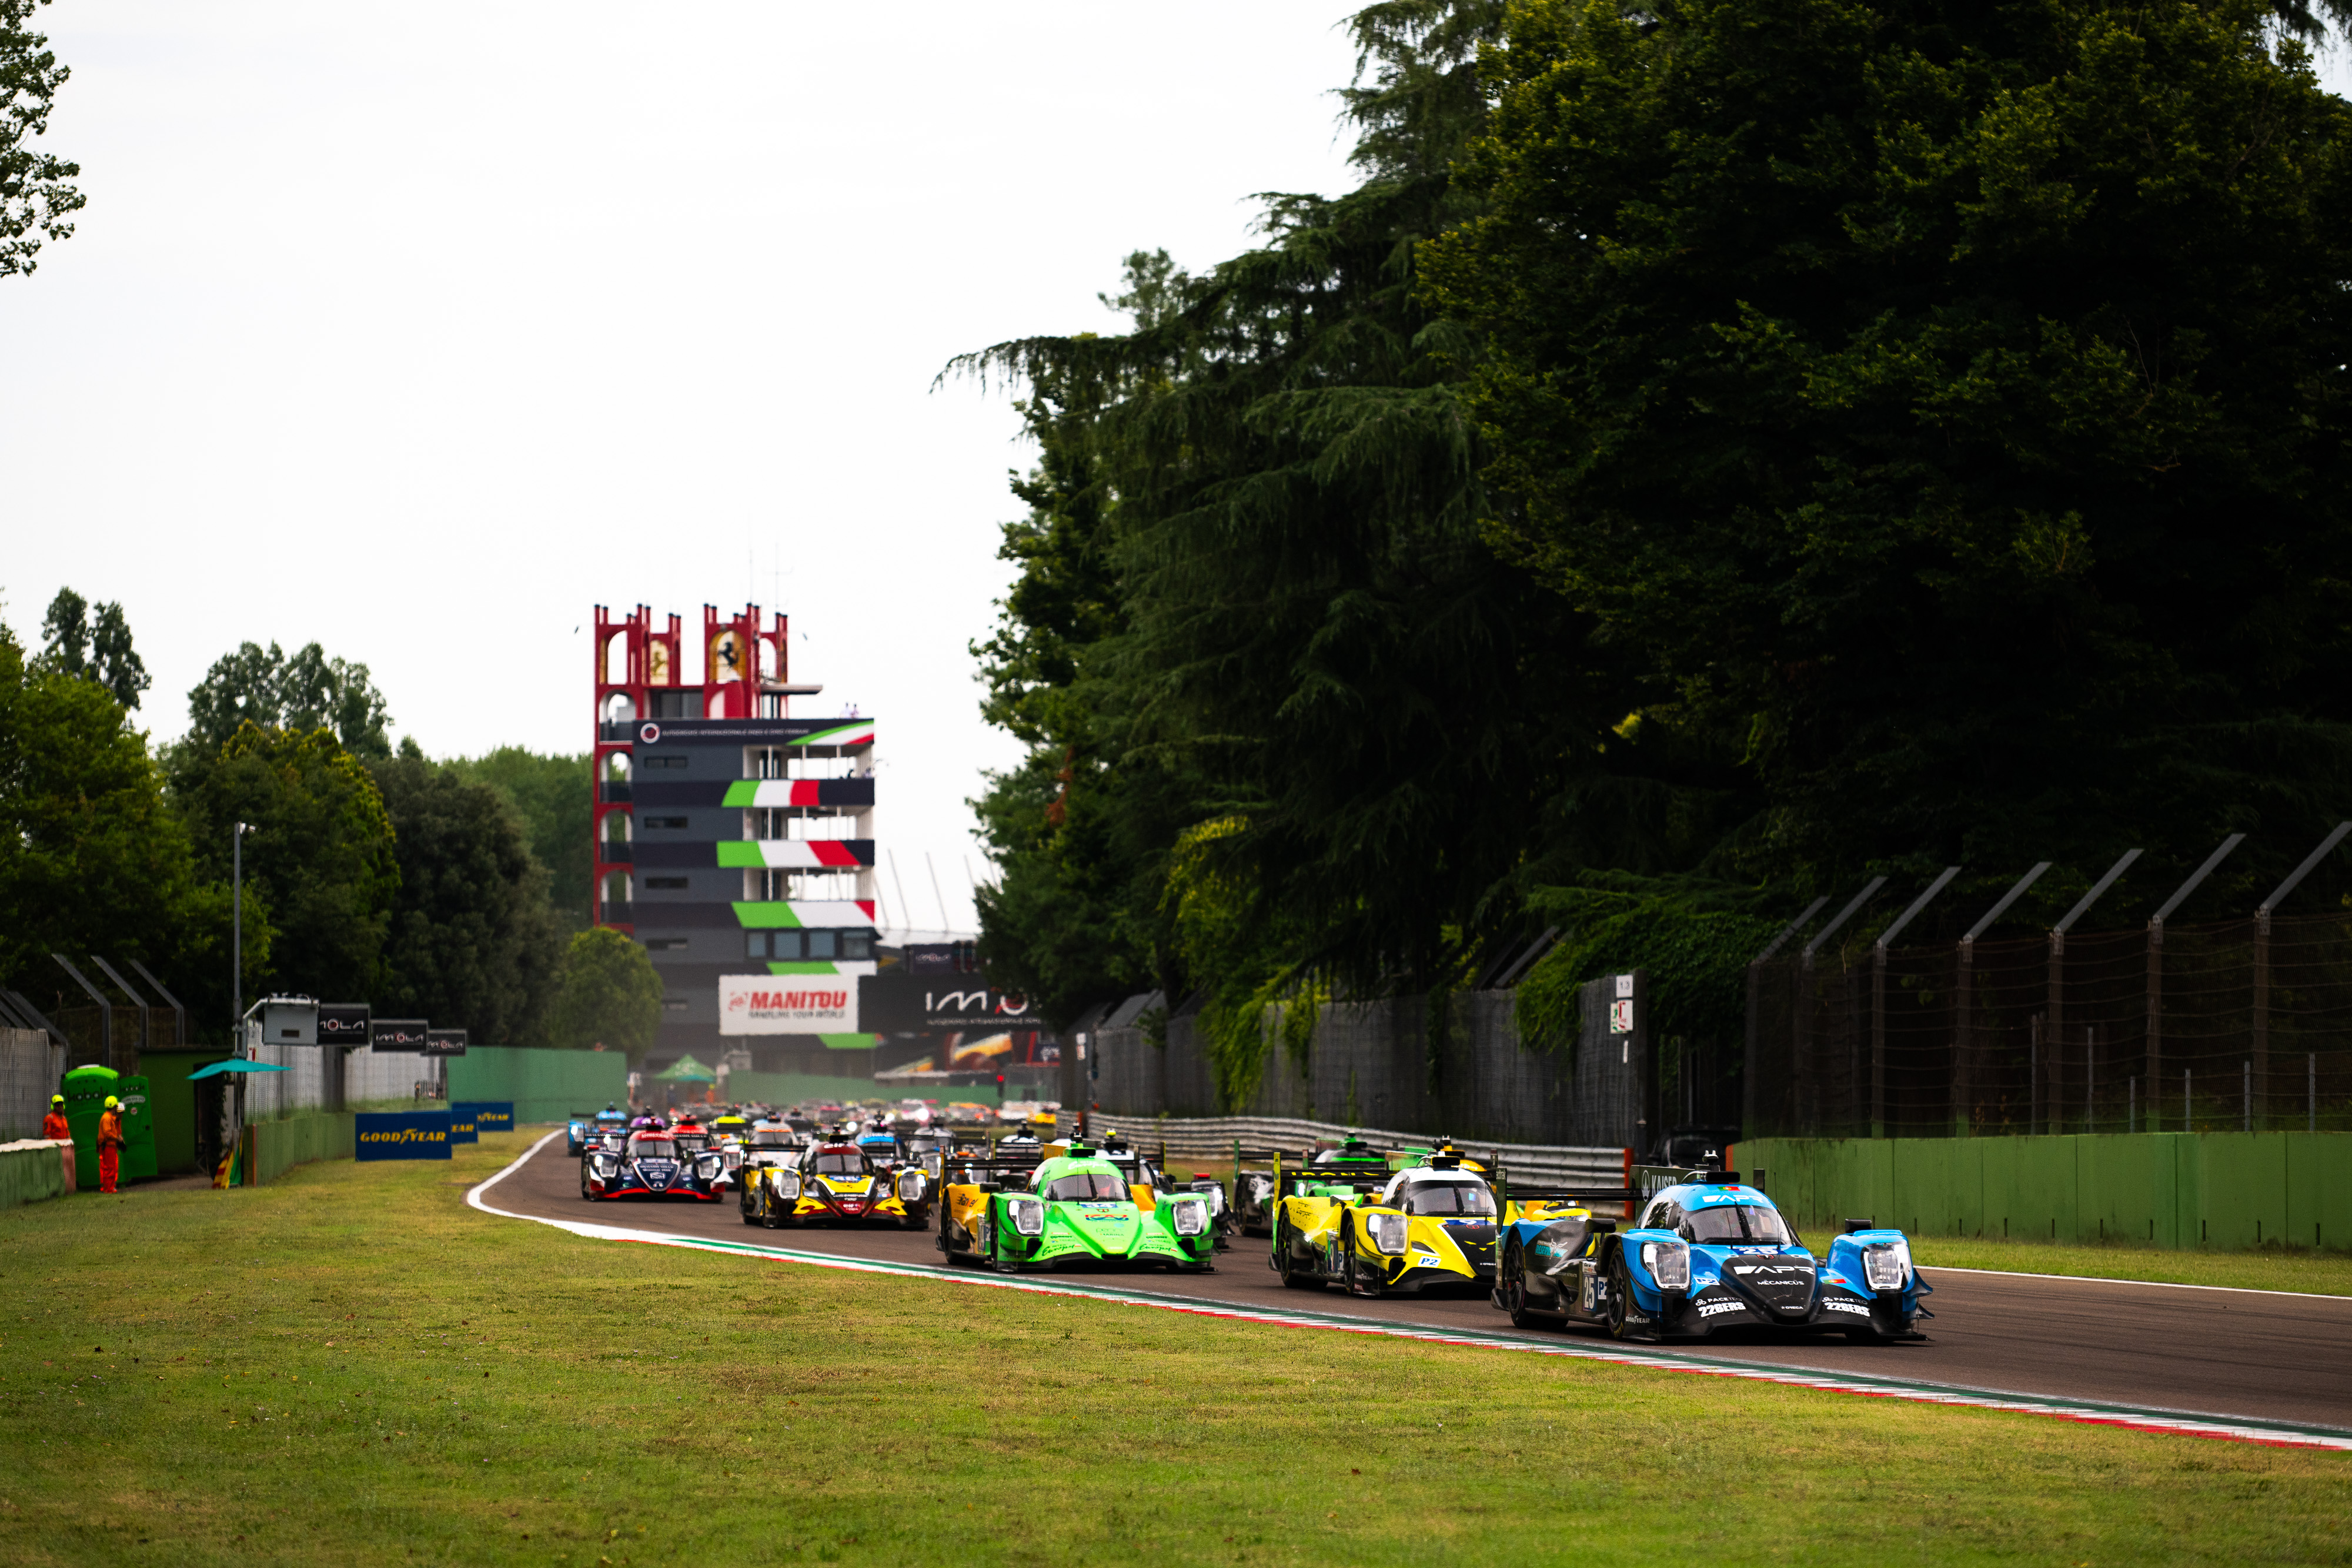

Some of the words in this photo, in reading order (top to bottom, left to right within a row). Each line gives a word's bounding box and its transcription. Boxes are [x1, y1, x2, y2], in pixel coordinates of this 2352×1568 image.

[750, 991, 847, 1009] MANITOU
[376, 1033, 425, 1044] IMOLA
[66, 1086, 108, 1102] kobak
[360, 1128, 446, 1145] GOODYEAR
[1421, 1258, 1438, 1266] P2
[1755, 1265, 1815, 1275] APR
[1584, 1276, 1595, 1309] 25
[1698, 1302, 1746, 1318] 226ERS
[1824, 1302, 1870, 1317] 226ERS
[1625, 1315, 1650, 1324] GOODYEAR
